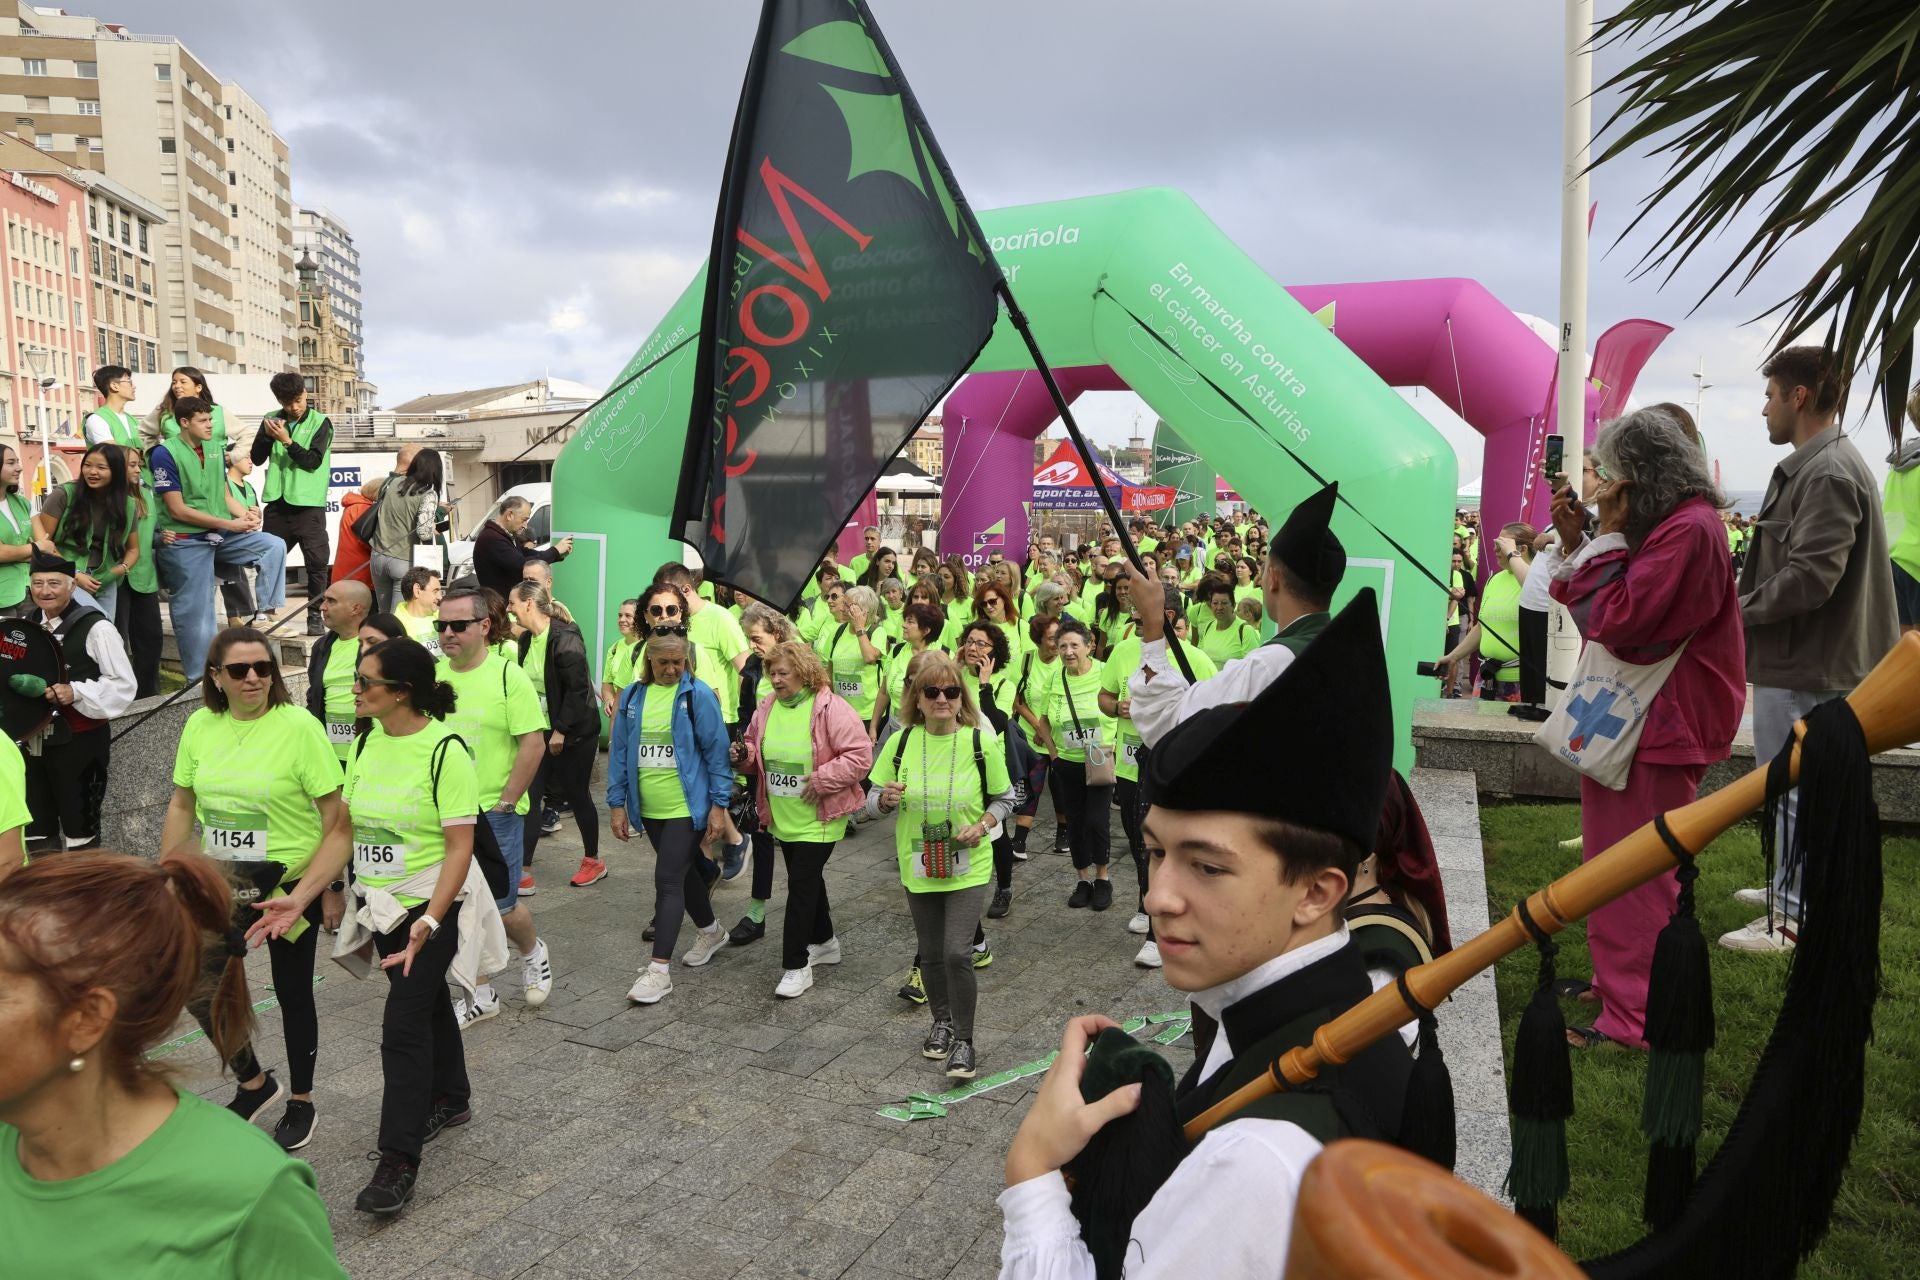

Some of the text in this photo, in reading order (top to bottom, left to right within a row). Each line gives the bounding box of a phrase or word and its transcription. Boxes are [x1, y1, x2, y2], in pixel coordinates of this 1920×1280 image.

[986, 224, 1080, 252] pañola
[1169, 262, 1306, 398] En marcha contra
[1150, 283, 1311, 442] el cáncer en Asturias
[583, 436, 596, 451] el
[628, 380, 644, 397] en
[330, 471, 361, 483] ORT
[1032, 488, 1100, 499] eporte.as
[838, 682, 858, 692] 1558
[640, 745, 674, 758] 0179
[770, 773, 798, 788] 0246
[212, 828, 256, 849] 1154
[358, 843, 394, 863] 1156
